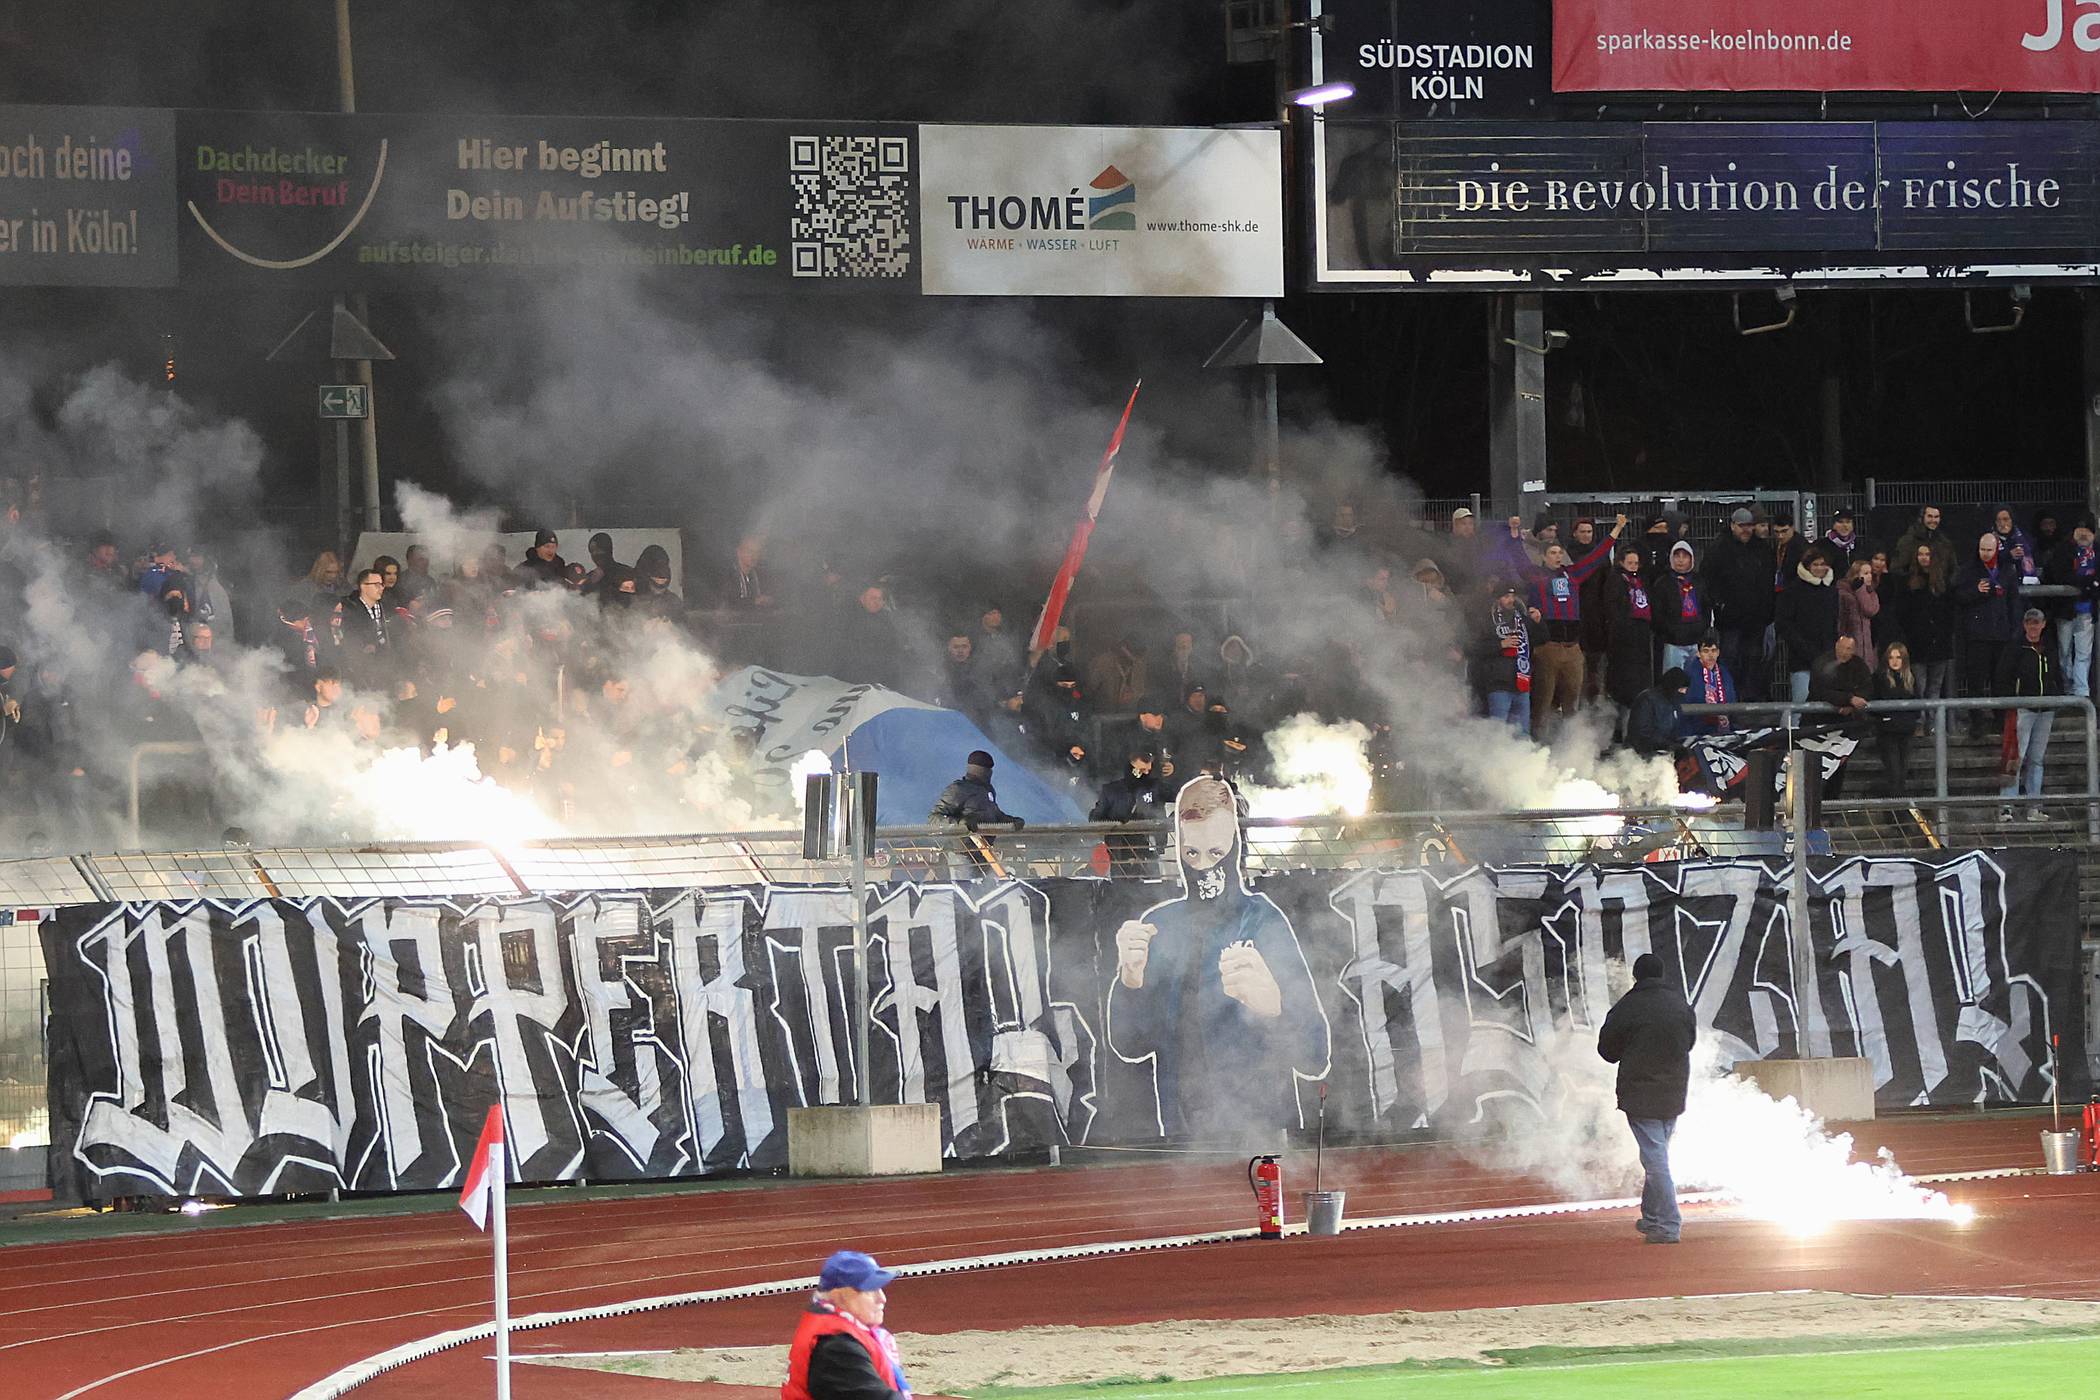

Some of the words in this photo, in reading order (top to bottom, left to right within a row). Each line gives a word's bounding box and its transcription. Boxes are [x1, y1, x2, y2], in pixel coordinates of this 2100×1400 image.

[1359, 38, 1534, 68] SÜDSTADION
[1596, 29, 1852, 54] sparkasse-koelnbonn.de
[1410, 70, 1484, 99] KÖLN
[55, 134, 132, 181] deine
[197, 145, 348, 174] Dachdecker
[458, 138, 528, 170] Hier
[538, 139, 667, 178] beginnt
[1455, 162, 1530, 211] Die
[1544, 162, 1800, 212] Revolution
[1812, 164, 1891, 211] der
[1901, 160, 2061, 210] Frische
[447, 189, 524, 221] Dein
[535, 190, 690, 229] Aufstieg!
[947, 188, 1085, 231] THOMÉ
[1146, 219, 1260, 233] www.thome-shk.de
[32, 208, 58, 253] in
[66, 208, 138, 254] Köln!
[1026, 238, 1078, 251] WASSER
[1088, 239, 1120, 251] LUFT
[76, 889, 1092, 1192] WUPPERTAL
